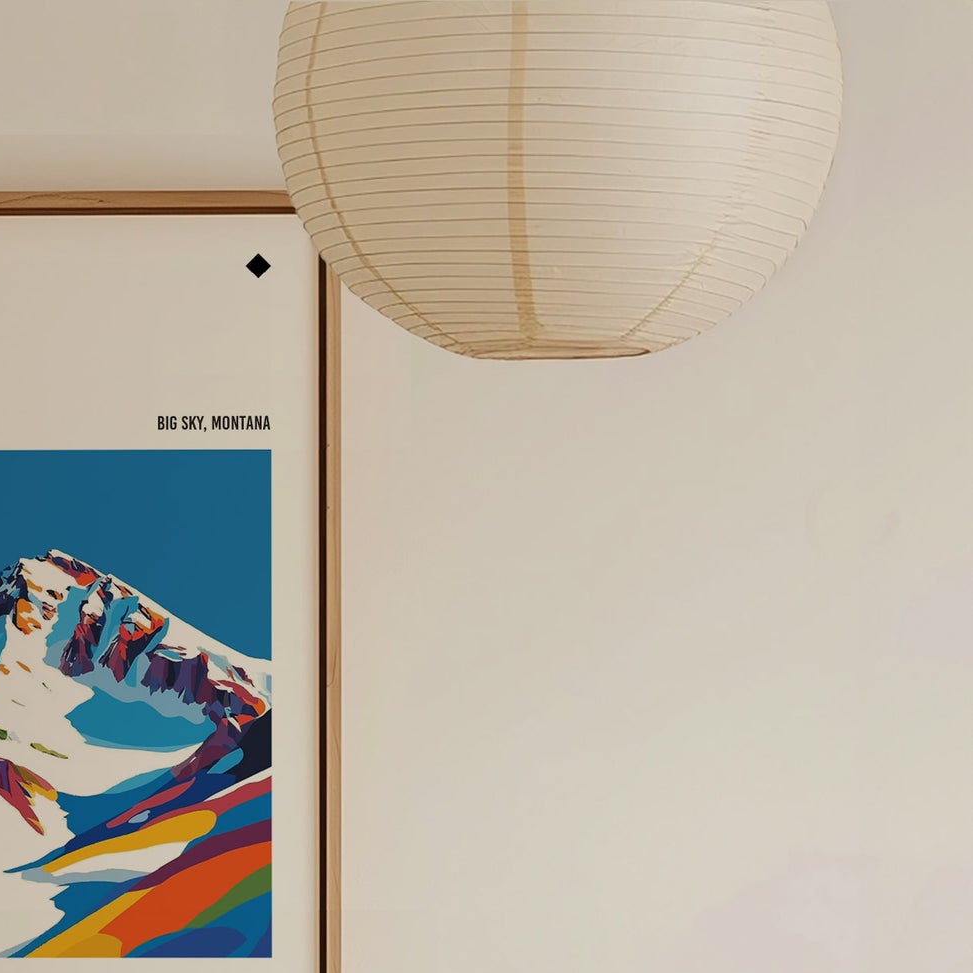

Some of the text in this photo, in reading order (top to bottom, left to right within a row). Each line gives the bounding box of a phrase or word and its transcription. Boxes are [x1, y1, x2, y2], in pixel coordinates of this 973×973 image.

[157, 415, 271, 432] BIG SKY, MONTANA
